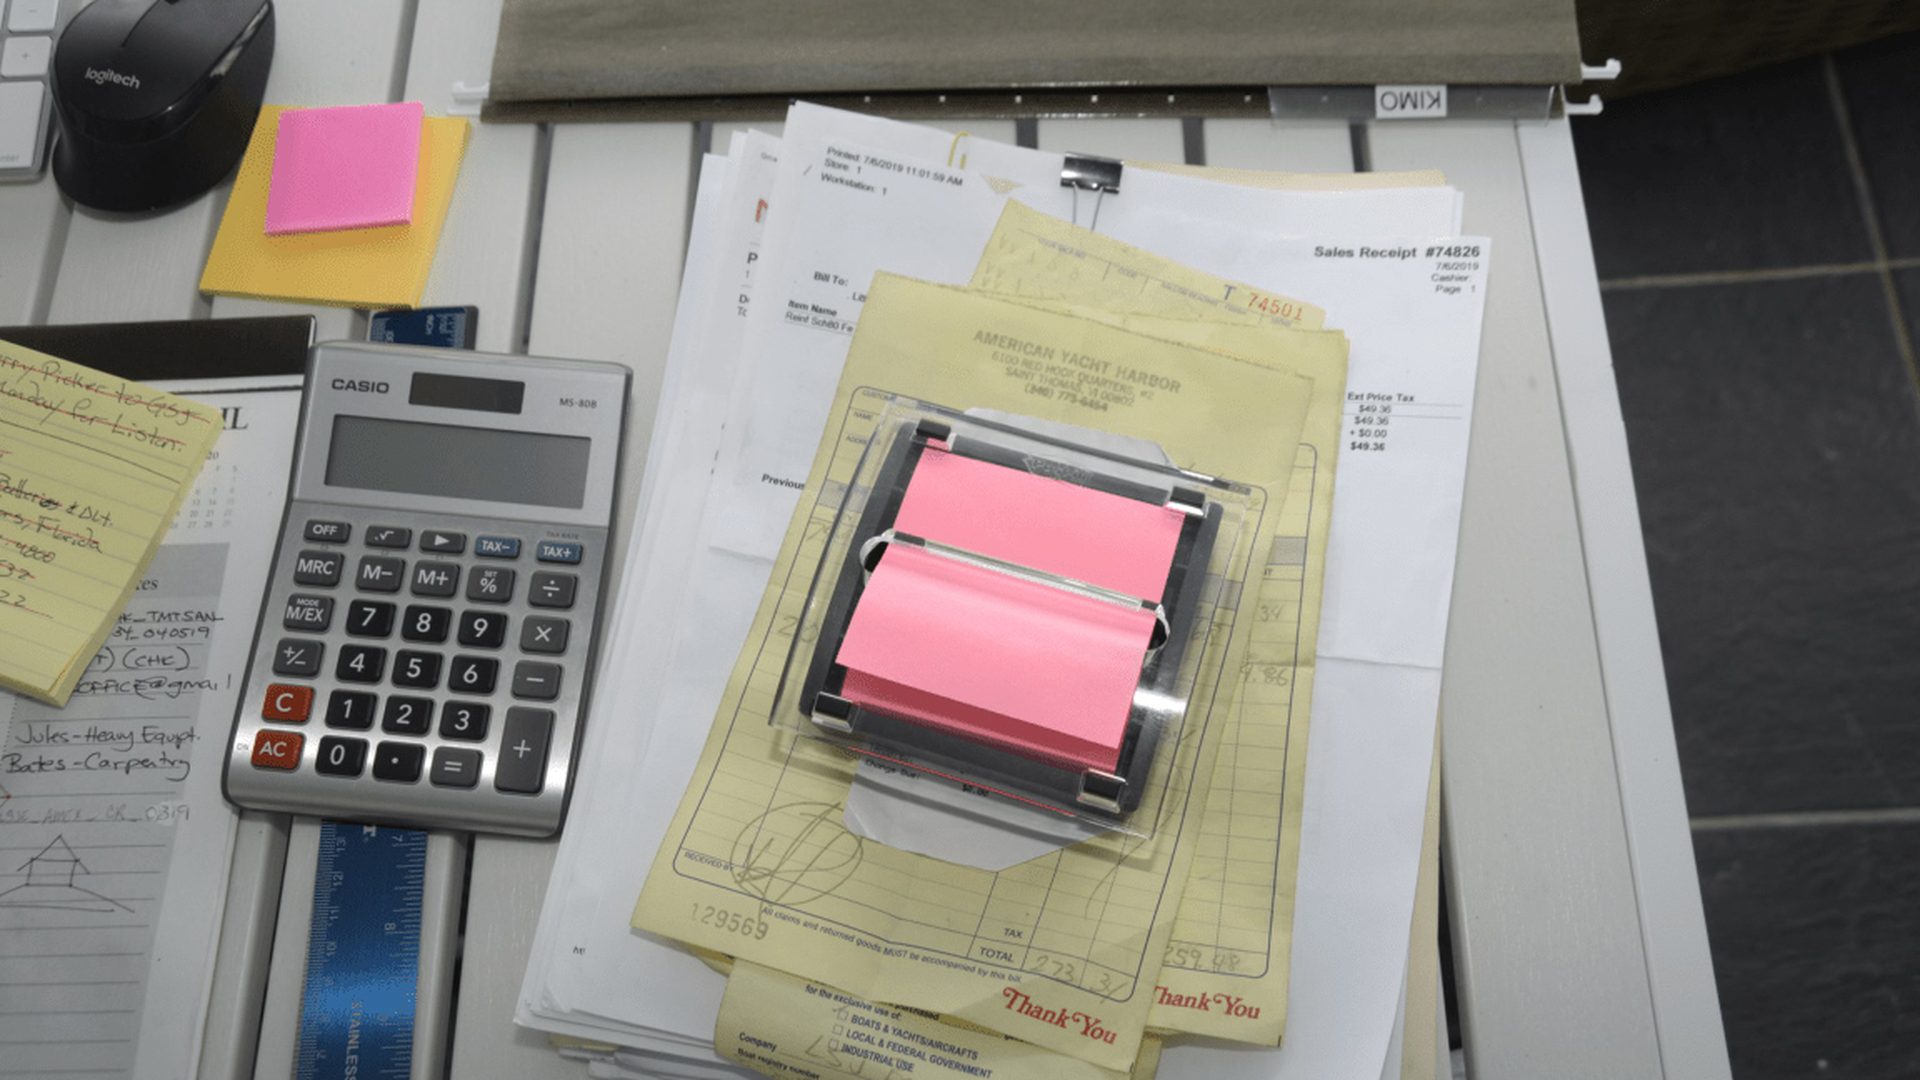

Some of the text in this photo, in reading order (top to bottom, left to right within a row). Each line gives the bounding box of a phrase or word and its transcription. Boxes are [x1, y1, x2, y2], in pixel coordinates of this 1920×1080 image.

[85, 67, 141, 89] logitech
[1381, 91, 1440, 111] KIMO
[946, 175, 963, 187] AM
[1314, 246, 1480, 260] Sales Receipt #74826
[813, 271, 830, 284] Bill
[1435, 284, 1461, 295] Page
[787, 299, 838, 318] Item Name
[1224, 284, 1236, 300] T
[1248, 293, 1303, 321] 74501
[973, 330, 1182, 393] AMERICAN YACHT HARBOR
[991, 351, 1019, 366] 6100
[1021, 358, 1043, 371] RED
[1045, 365, 1074, 379] HOOK
[1005, 367, 1035, 382] SAINT
[331, 378, 390, 394] CASIO
[559, 398, 597, 409] MS-80B
[1347, 392, 1414, 402] Ext Price Tax
[312, 524, 339, 536] OFF
[297, 558, 335, 575] MRC
[417, 569, 449, 586] M+
[480, 577, 497, 594] %
[296, 598, 320, 608] MODE
[286, 606, 324, 623] M/EX
[362, 607, 376, 627] 7
[416, 612, 432, 632] 8
[473, 618, 488, 638] 9
[350, 653, 364, 672] 4
[406, 658, 422, 678] 5
[463, 664, 478, 683] 6
[275, 693, 294, 712] C
[344, 699, 352, 719] 1
[396, 704, 412, 725] 2
[454, 710, 470, 731] 3
[259, 741, 287, 757] AC
[330, 744, 345, 765] 0
[684, 851, 722, 869] RECEIVED
[690, 902, 769, 941] 129569
[1003, 927, 1024, 939] TAX
[761, 906, 773, 916] All
[774, 910, 801, 926] claims
[803, 920, 818, 931] and
[820, 925, 855, 944] returned
[856, 938, 881, 955] goods
[883, 947, 907, 960] MUST
[909, 952, 920, 962] be
[921, 953, 976, 975] accompanied
[977, 967, 988, 978] by
[989, 969, 1005, 981] this
[979, 946, 1015, 963] TOTAL
[805, 984, 819, 995] for
[819, 988, 833, 999] the
[833, 993, 873, 1013] exclusive
[874, 1006, 890, 1016] use
[1212, 992, 1261, 1020] You
[1002, 986, 1119, 1045] Thank You
[738, 1032, 777, 1053] Company
[851, 1014, 979, 1061] BOATS & YACHTS/AIRCRAFTS
[841, 1043, 914, 1072] INDUSTRIAL USE
[846, 1029, 992, 1079] LOCAL & FEDERAL GOVERNMENT
